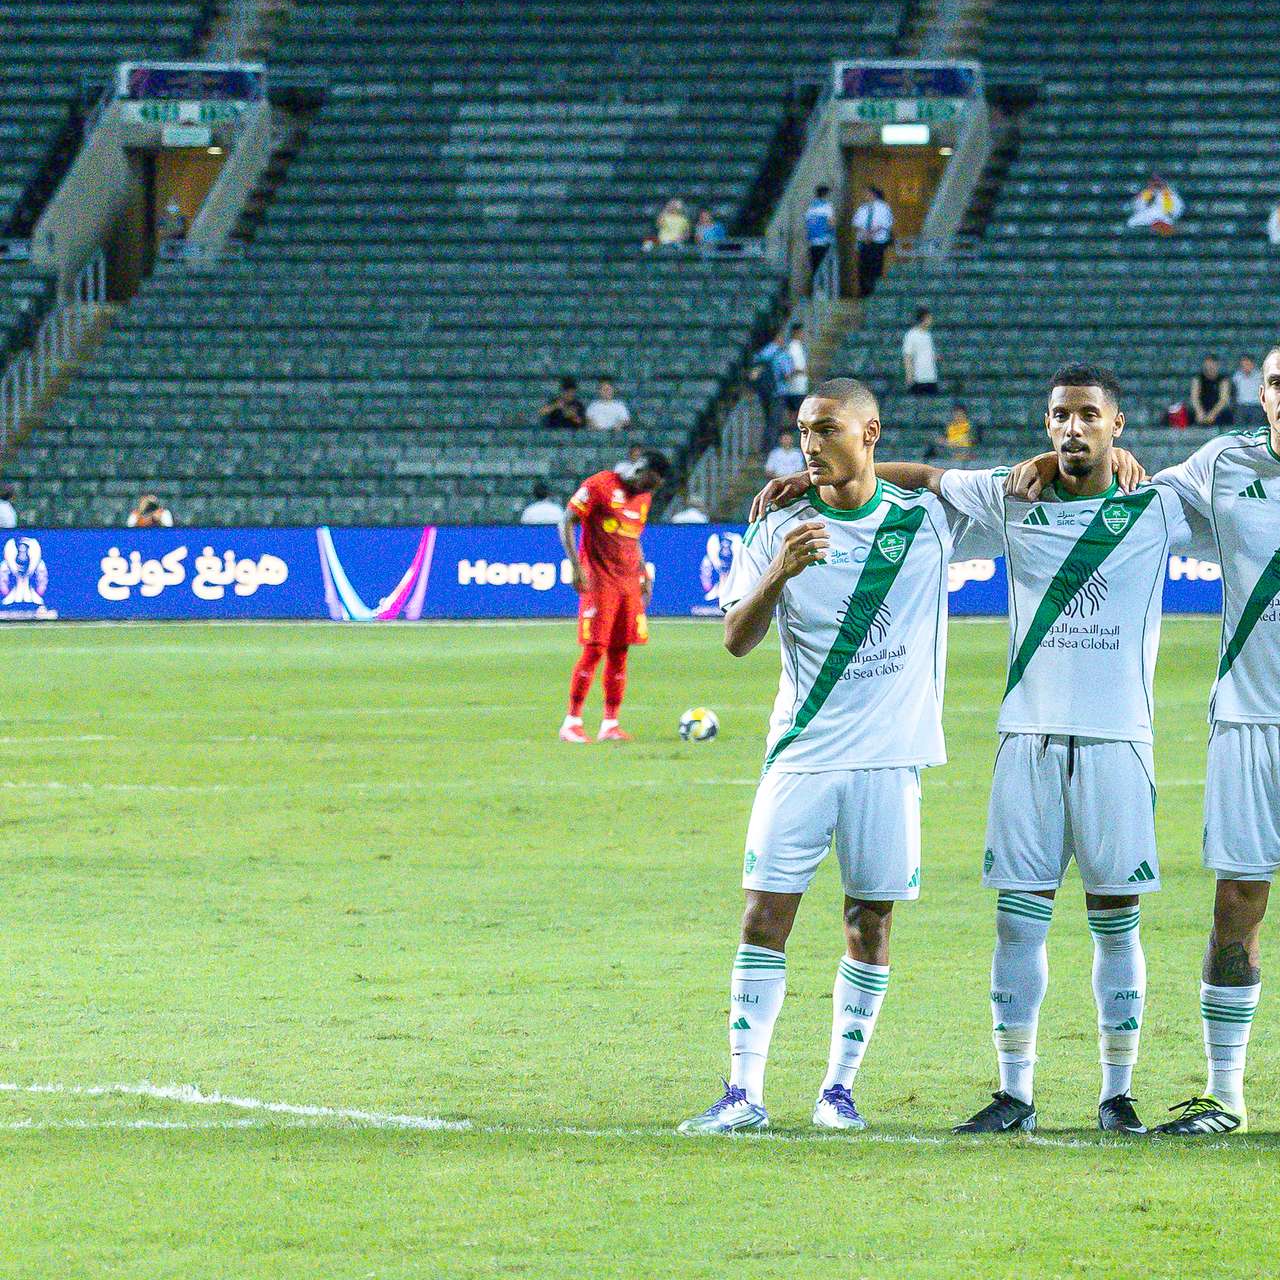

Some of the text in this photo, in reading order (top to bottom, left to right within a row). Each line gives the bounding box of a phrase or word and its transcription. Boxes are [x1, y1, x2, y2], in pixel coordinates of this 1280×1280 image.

[457, 558, 556, 590] Hong
[1057, 638, 1078, 649] Sea
[1081, 638, 1120, 650] Global
[853, 669, 872, 680] Sea
[844, 1004, 873, 1017] AHLI
